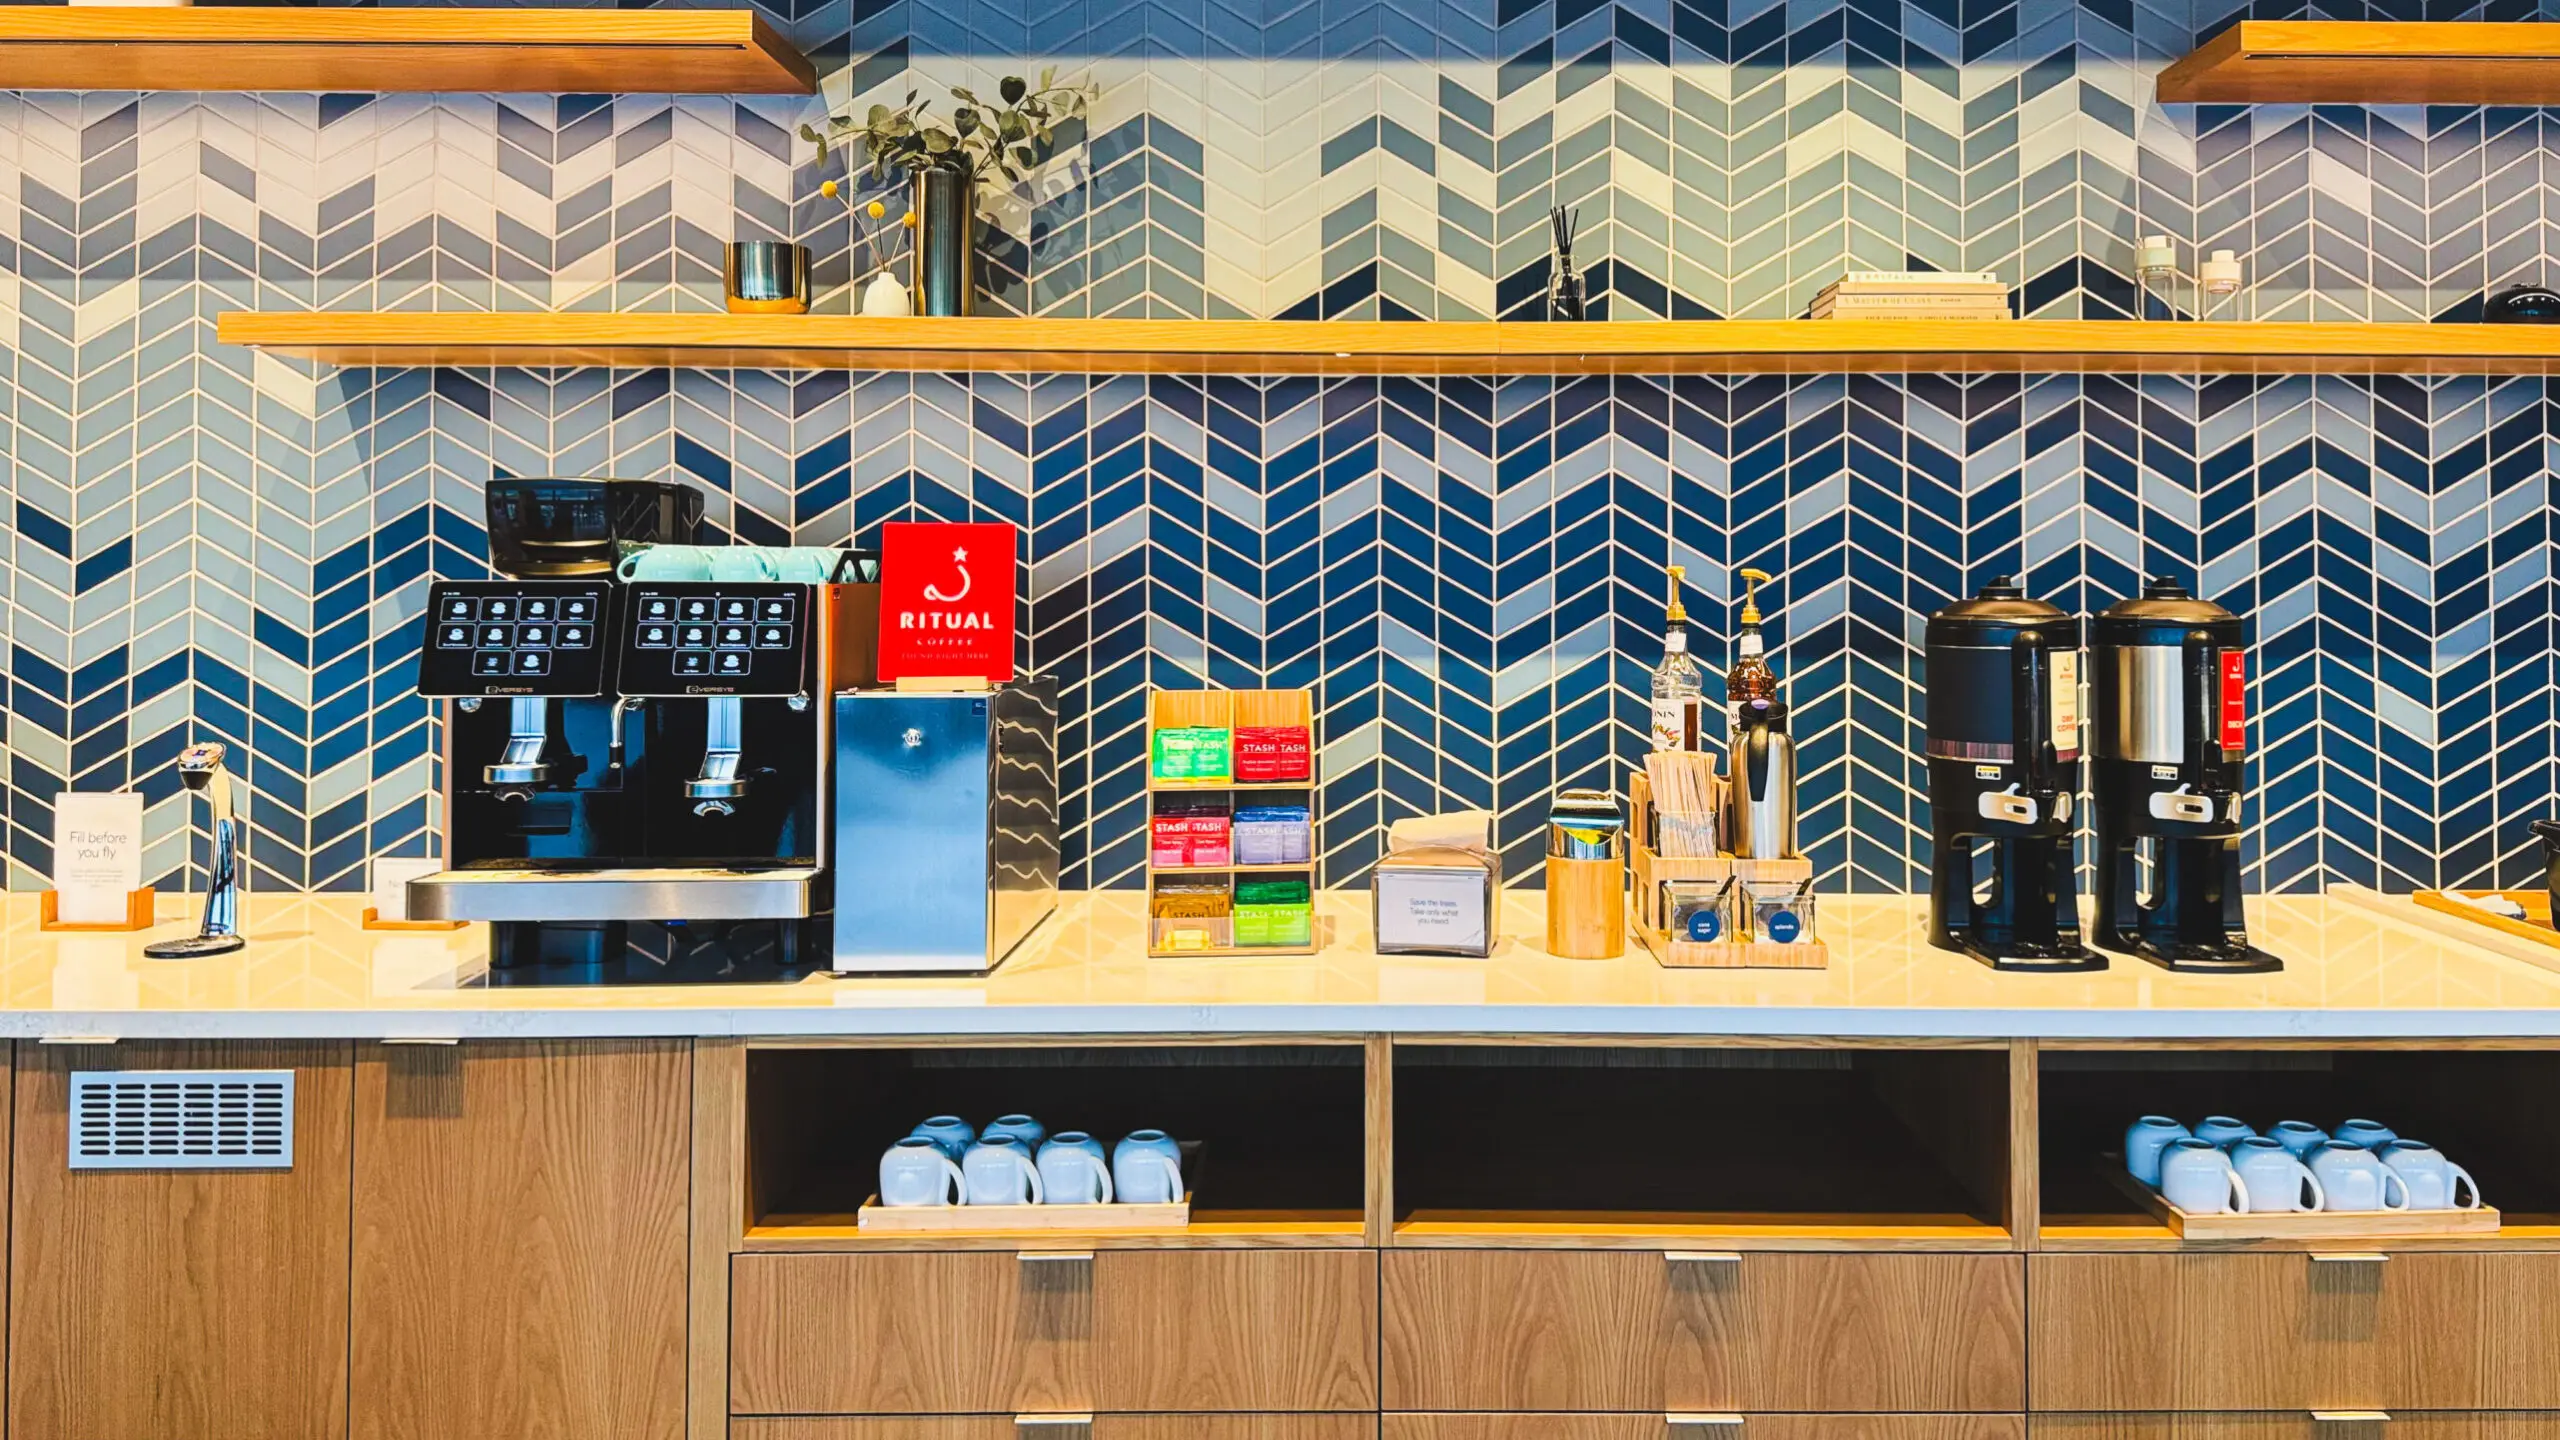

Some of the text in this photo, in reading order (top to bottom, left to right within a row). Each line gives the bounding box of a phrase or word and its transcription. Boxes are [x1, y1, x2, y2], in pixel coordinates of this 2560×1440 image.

[900, 611, 995, 629] RITUAL
[916, 637, 973, 646] COFFEE
[1243, 743, 1275, 752] STASH
[1280, 743, 1306, 752] TASH
[1155, 823, 1188, 832] STASH
[70, 831, 127, 844] Fill before
[78, 846, 116, 860] you fly
[1410, 898, 1426, 906] Save
[1410, 907, 1425, 916] Take
[1442, 908, 1459, 916] what
